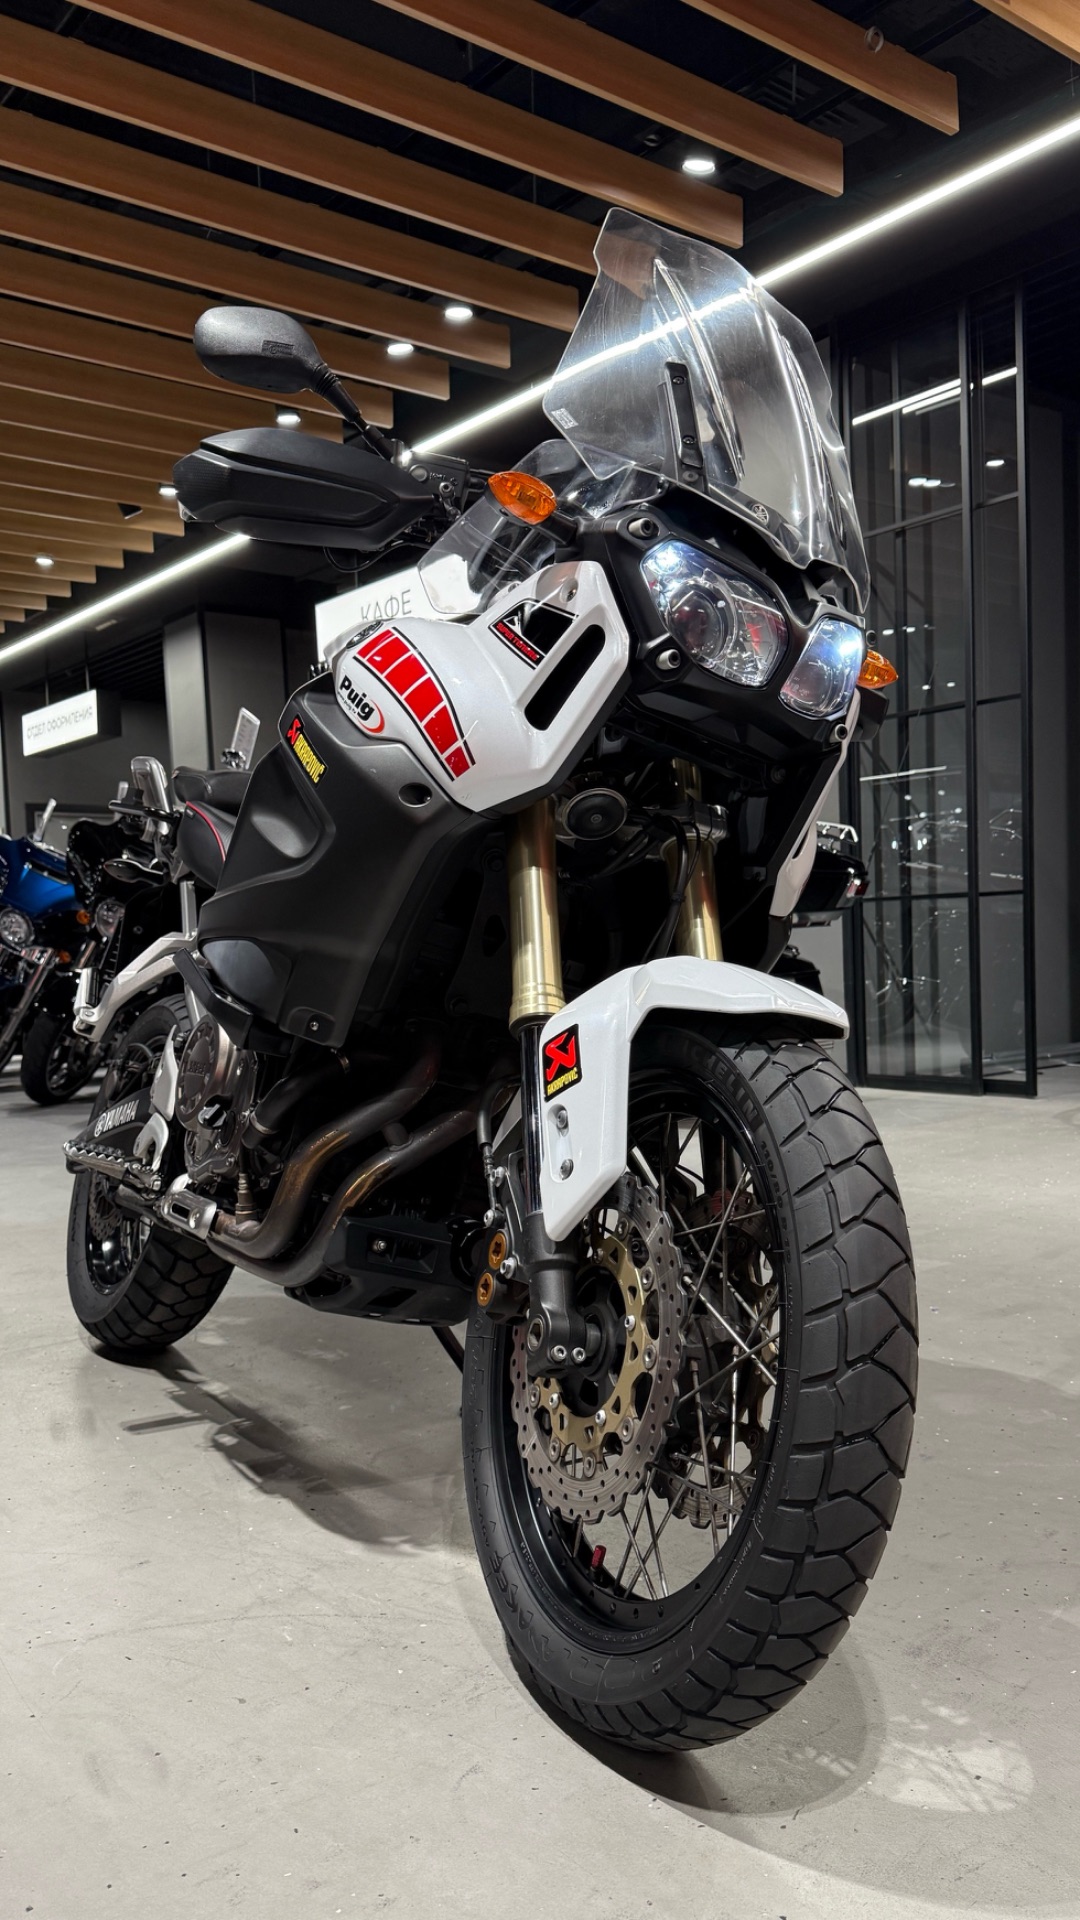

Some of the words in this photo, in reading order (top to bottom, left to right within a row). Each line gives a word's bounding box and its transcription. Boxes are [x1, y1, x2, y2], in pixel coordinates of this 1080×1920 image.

[361, 589, 412, 621] КАФЕ
[339, 674, 376, 722] Puig
[102, 1099, 140, 1133] YAMAHA
